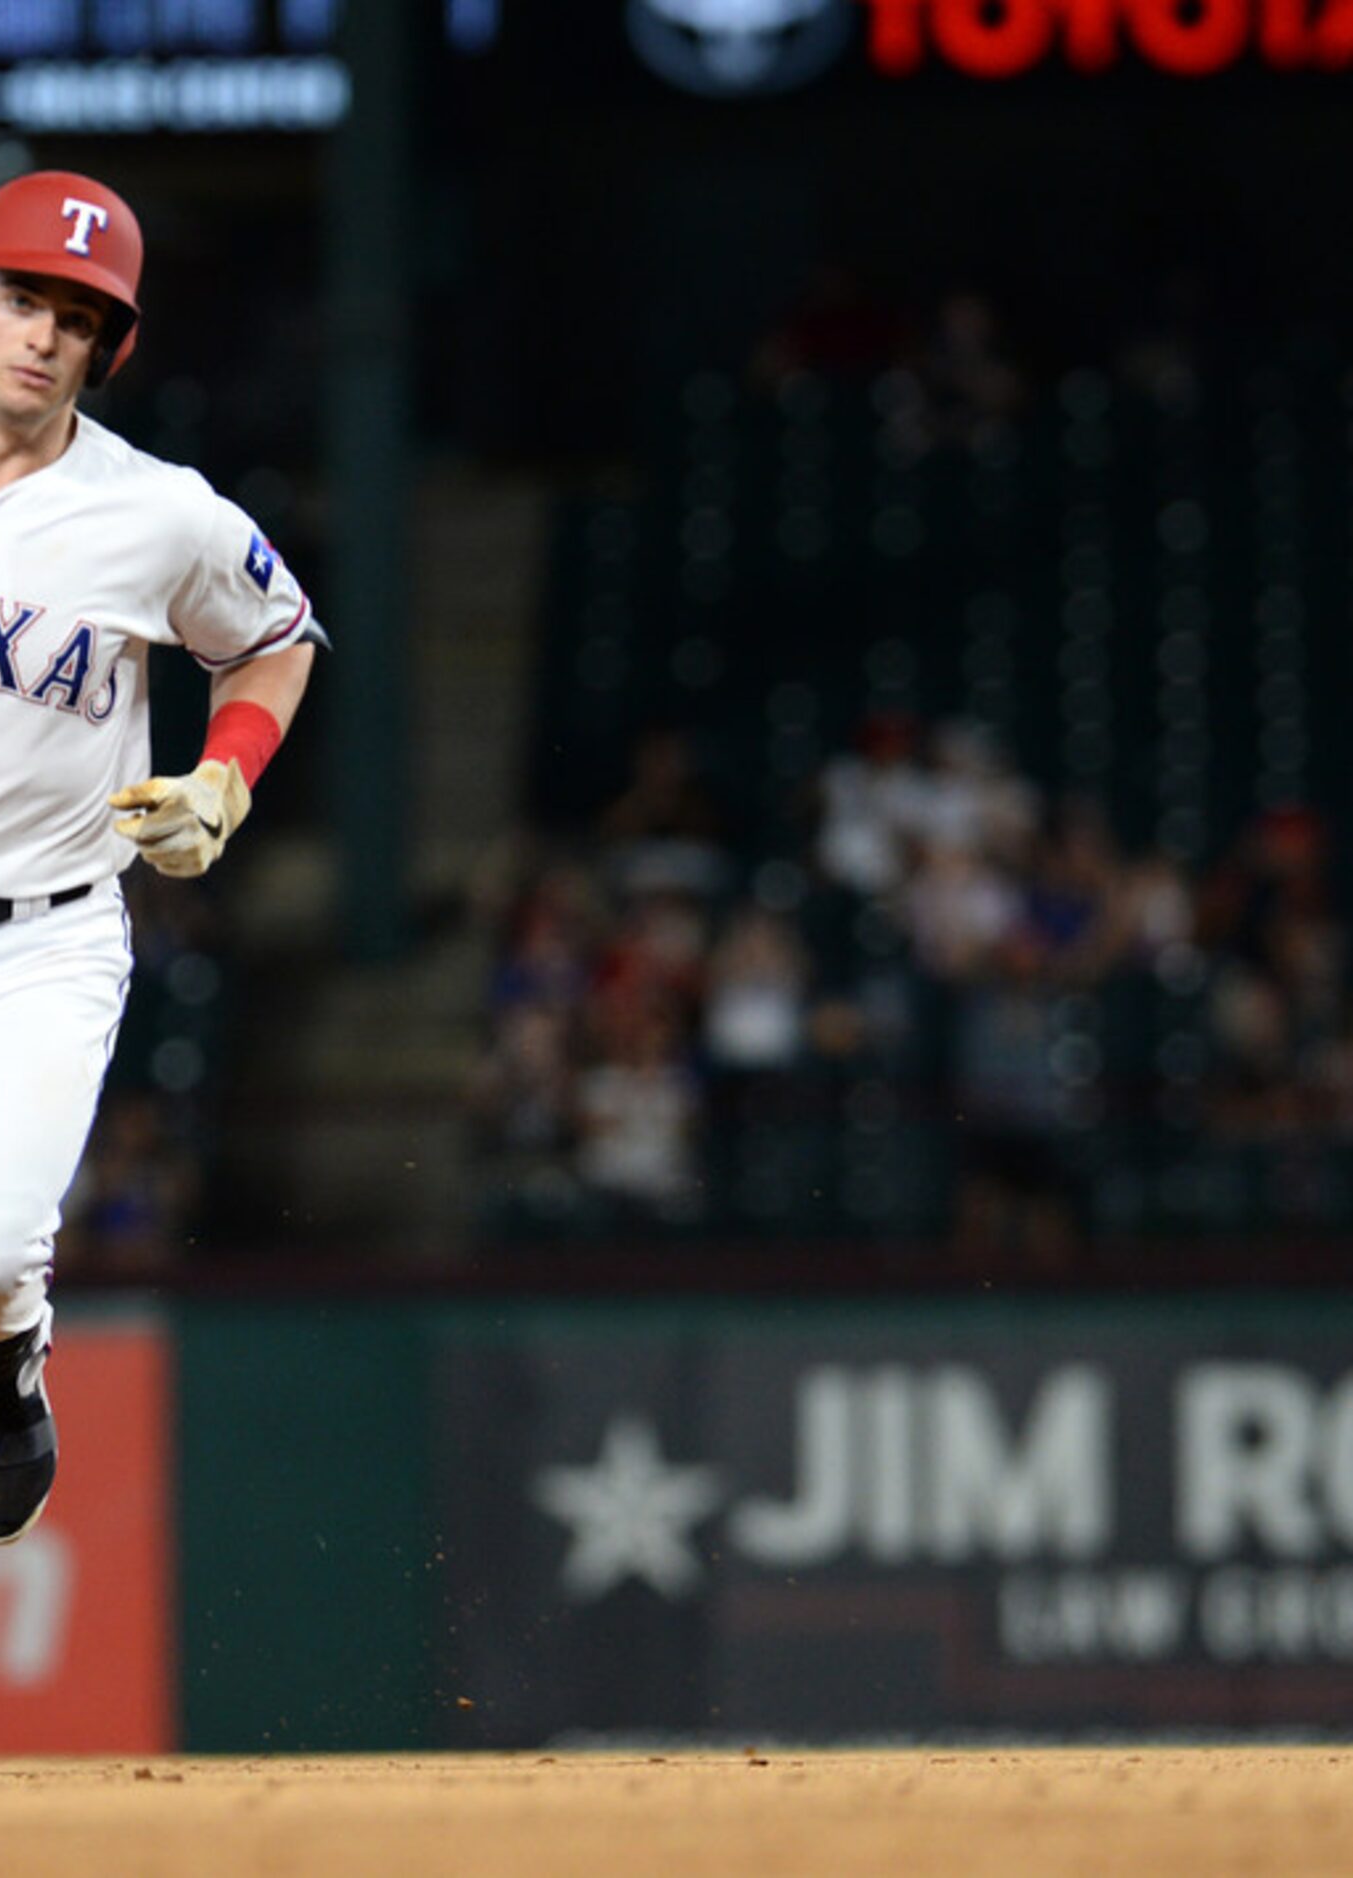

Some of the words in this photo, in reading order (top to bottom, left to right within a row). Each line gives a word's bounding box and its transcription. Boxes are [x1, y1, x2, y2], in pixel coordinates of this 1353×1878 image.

[61, 197, 108, 257] T
[731, 1364, 1112, 1563] JIM
[1174, 1362, 1353, 1560] R
